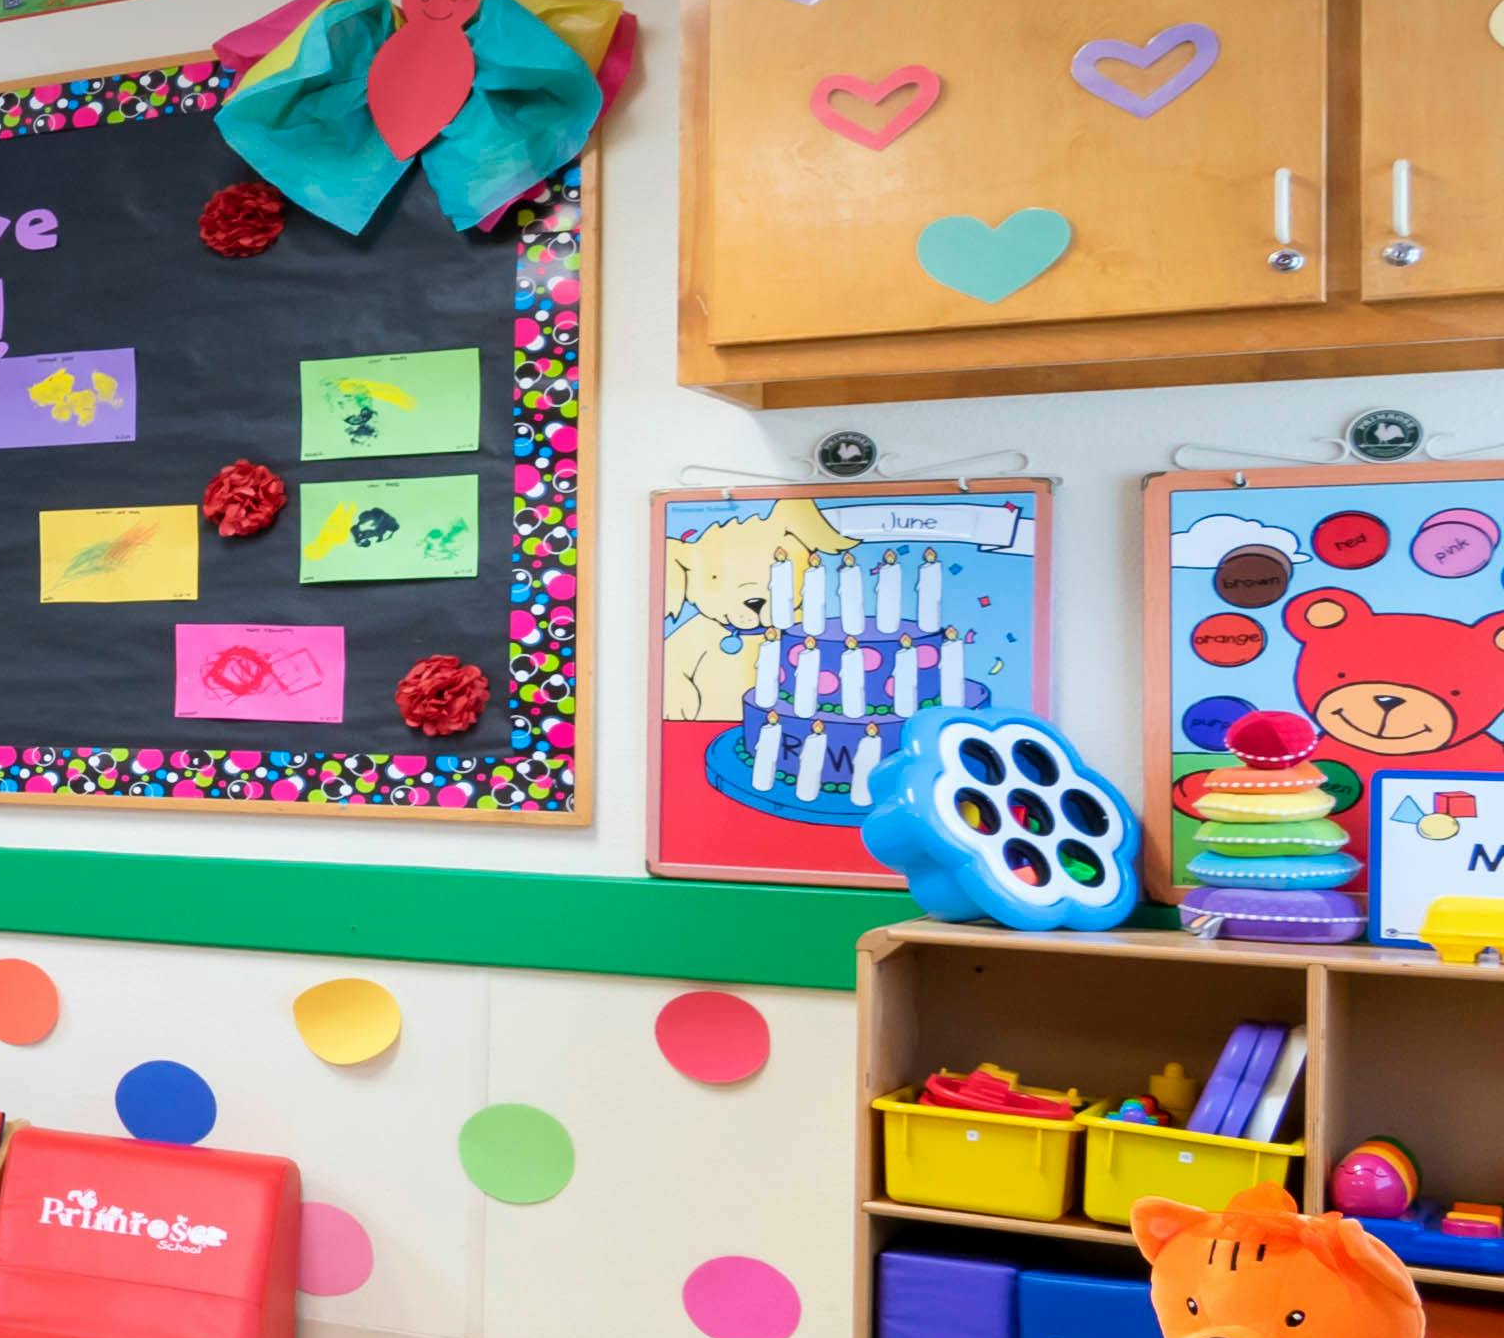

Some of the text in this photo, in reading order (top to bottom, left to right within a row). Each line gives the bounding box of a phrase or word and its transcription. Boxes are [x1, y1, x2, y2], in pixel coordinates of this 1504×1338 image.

[881, 511, 938, 532] June
[1334, 533, 1367, 552] red
[1434, 538, 1470, 563] pink
[1222, 575, 1282, 590] brown
[1194, 632, 1260, 647] orange
[1191, 716, 1229, 730] purp
[38, 1191, 228, 1247] Primrose
